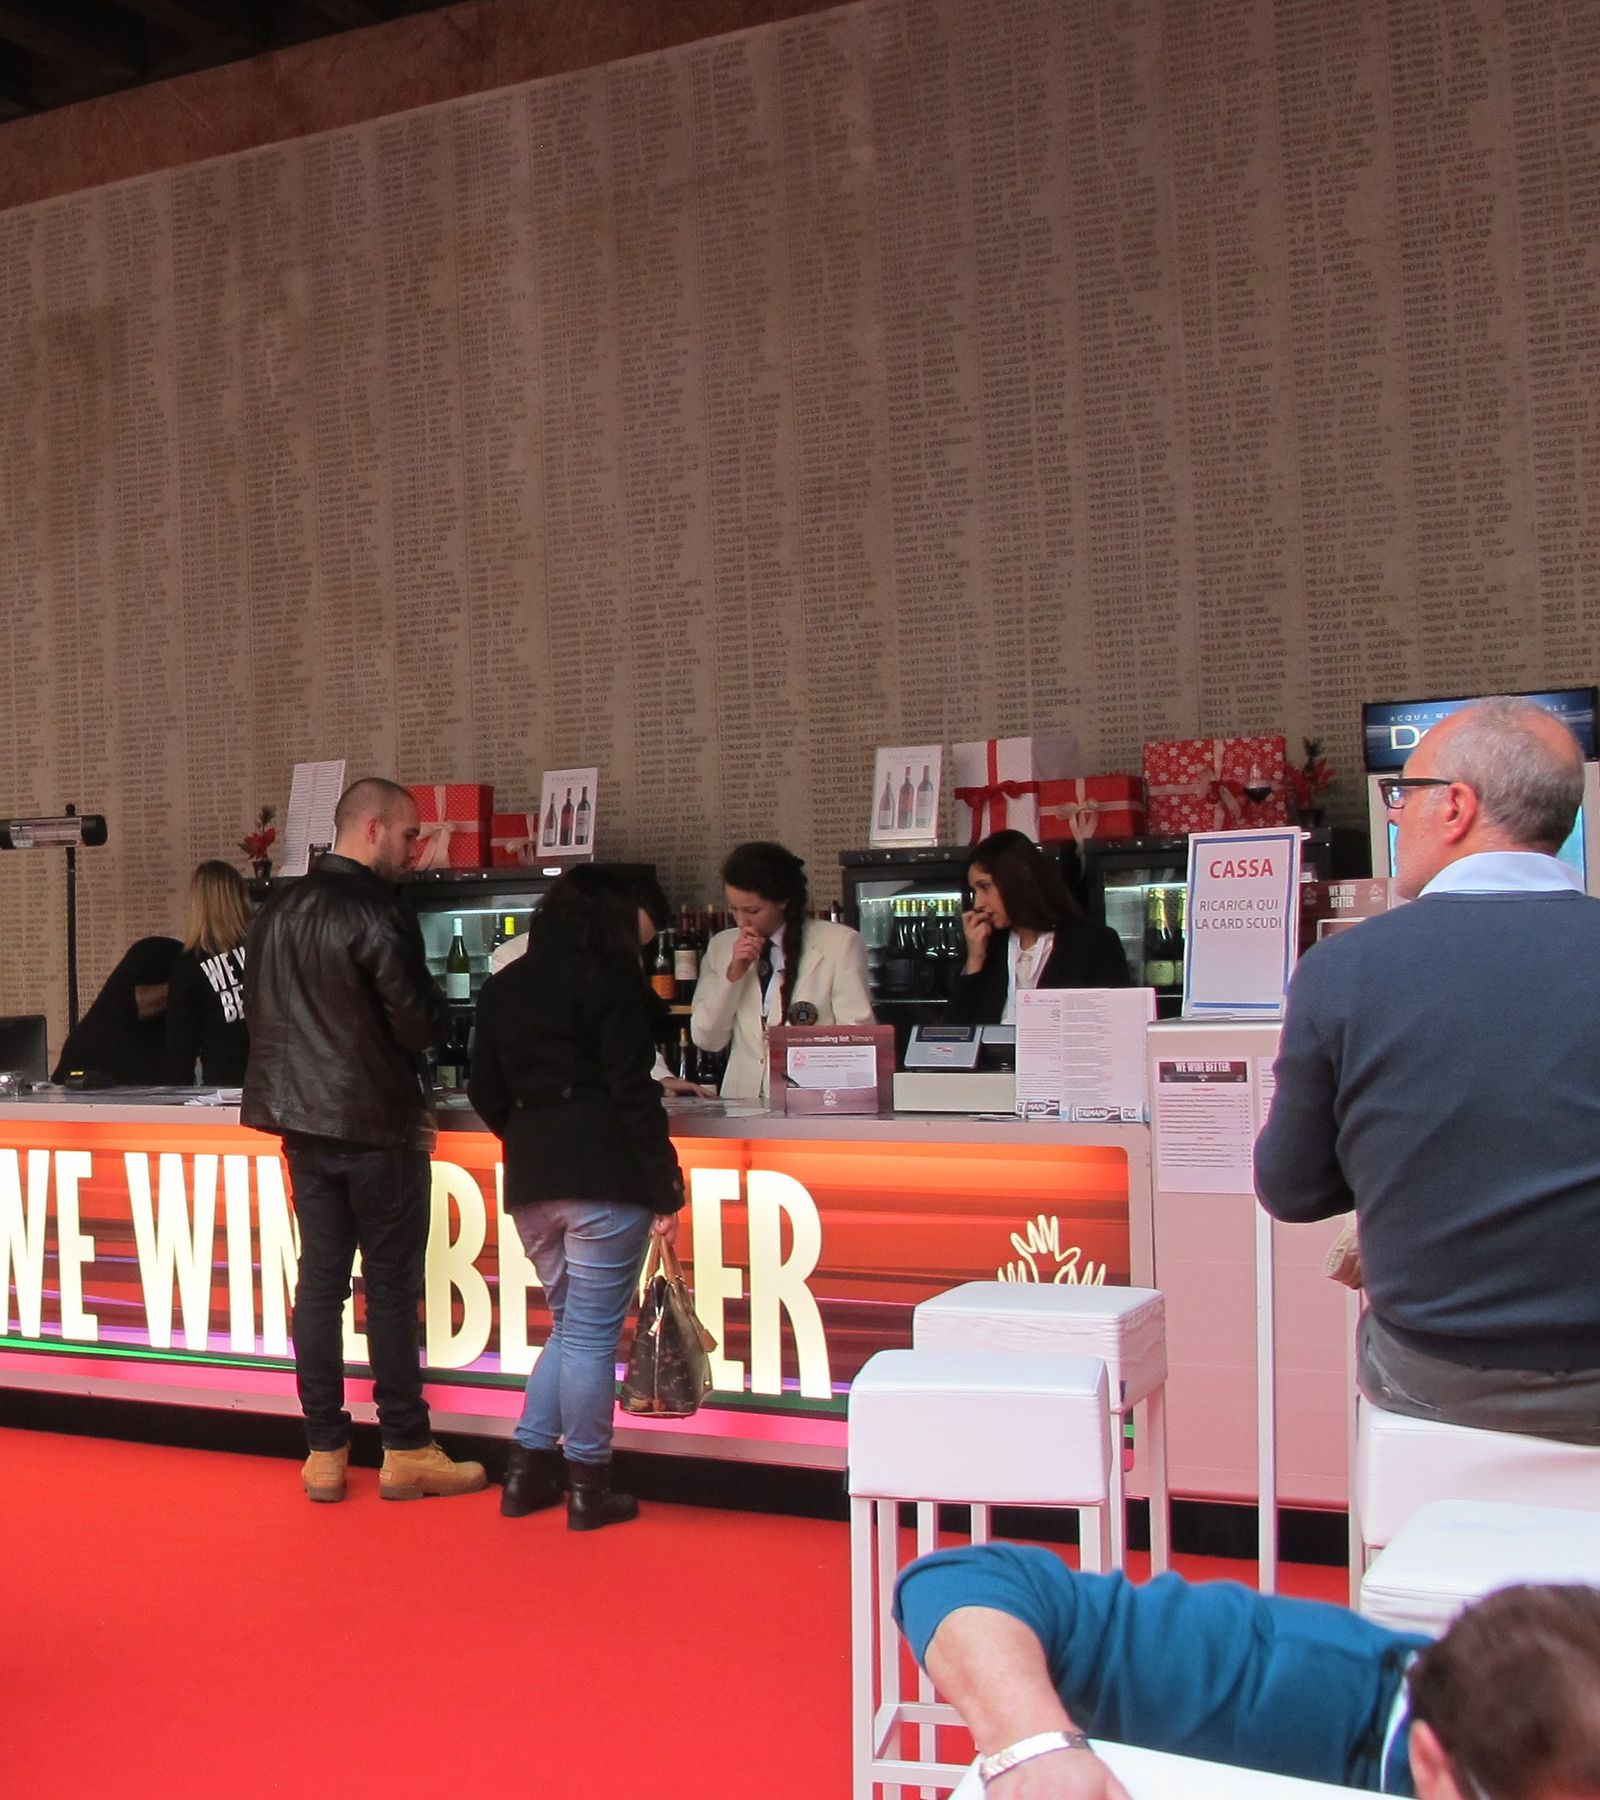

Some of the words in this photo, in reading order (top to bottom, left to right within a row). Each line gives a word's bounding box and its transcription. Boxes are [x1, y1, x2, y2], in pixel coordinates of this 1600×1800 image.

[1209, 858, 1274, 879] CASSA
[1328, 885, 1340, 897] WE
[1340, 884, 1357, 897] WINE
[1199, 899, 1253, 912] RICARICA
[1256, 899, 1279, 911] QUI
[1330, 896, 1355, 909] BETTER
[1195, 918, 1210, 930] LA
[1212, 917, 1244, 930] CARD
[1246, 916, 1282, 929] SCUDI
[200, 952, 238, 993] WE
[813, 1036, 838, 1044] mailing
[1174, 1062, 1187, 1072] WE
[1205, 1062, 1231, 1072] BETTER
[124, 1151, 370, 1363] WIN
[425, 1160, 833, 1399] BEER
